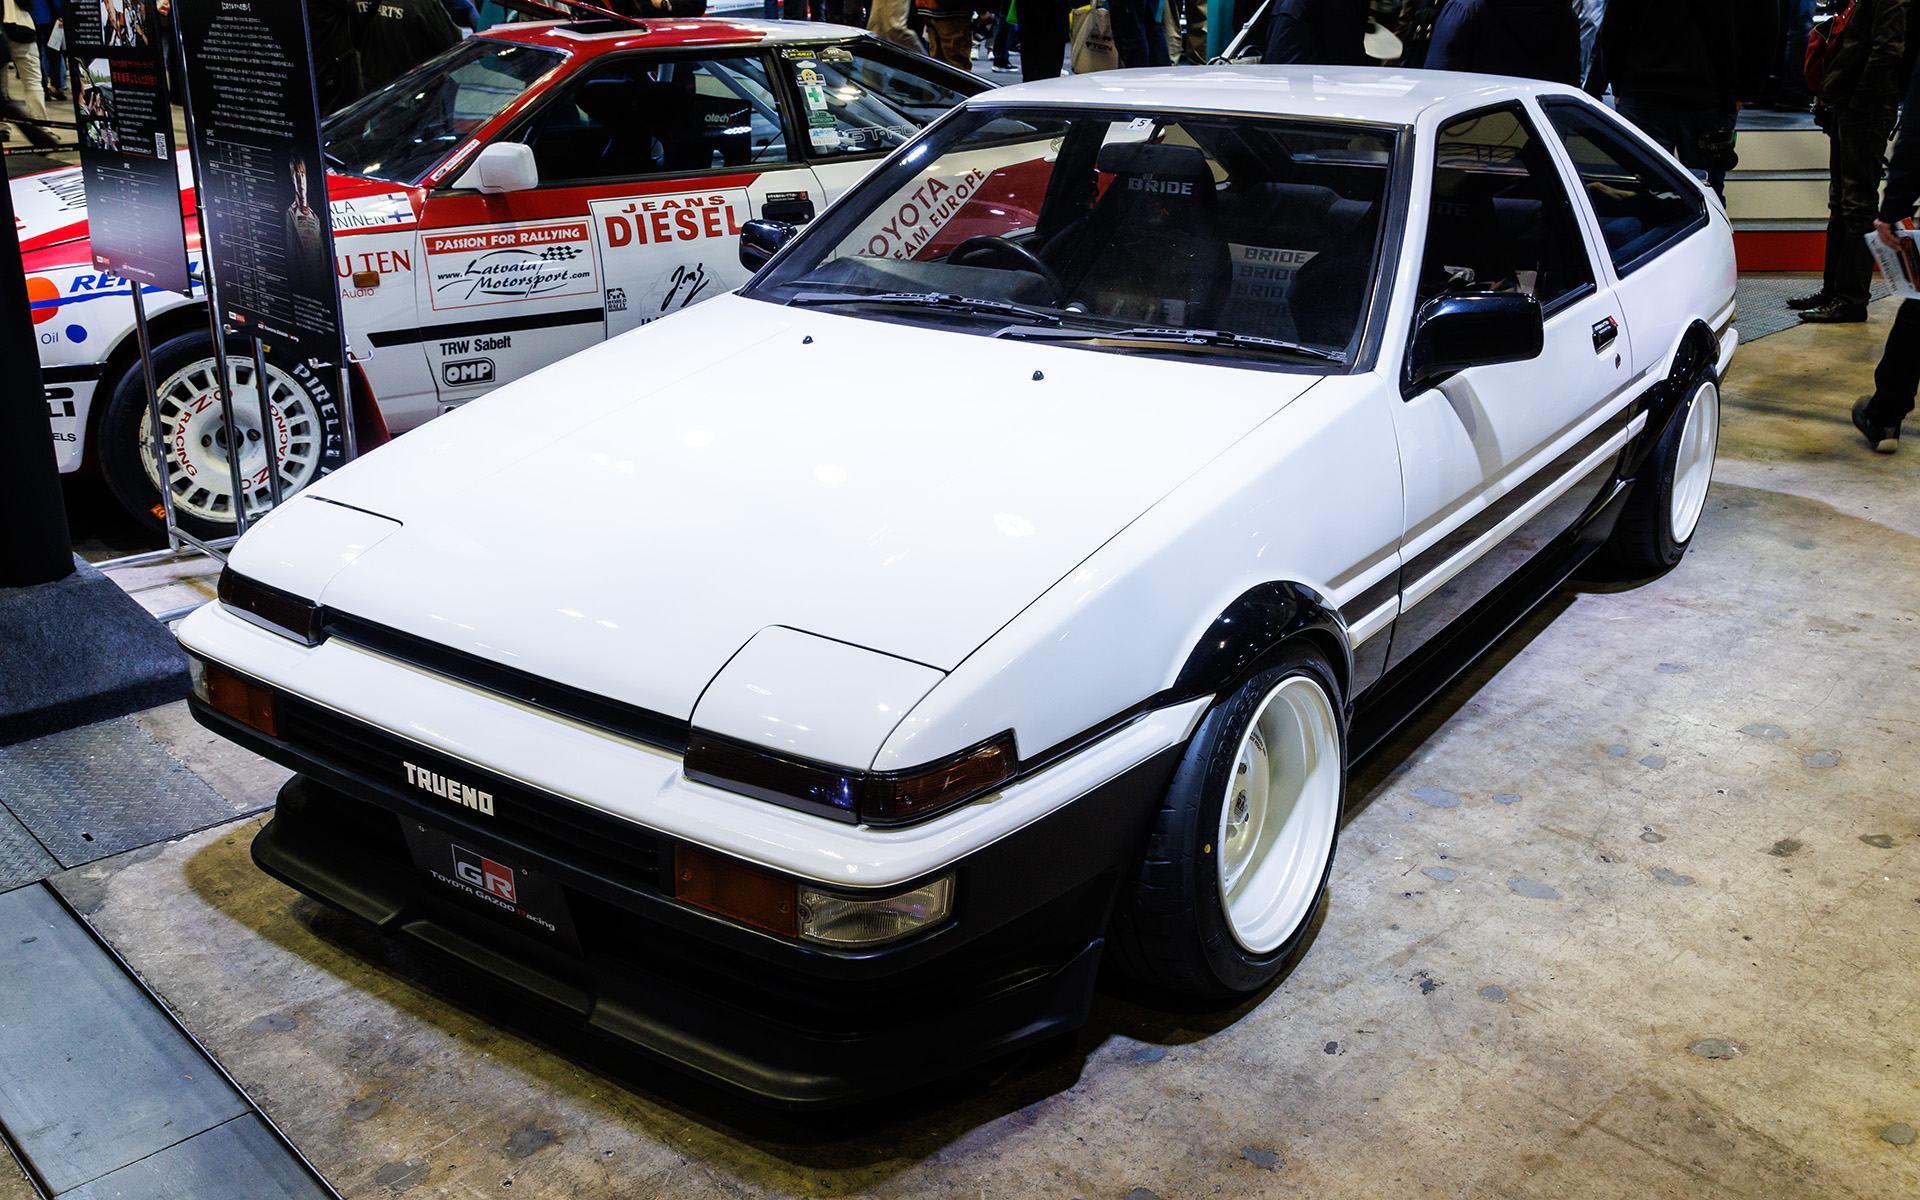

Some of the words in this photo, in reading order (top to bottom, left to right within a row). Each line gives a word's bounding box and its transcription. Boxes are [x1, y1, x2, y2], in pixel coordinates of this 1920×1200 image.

[1127, 177, 1194, 195] BRIDE
[622, 195, 726, 214] JEANS
[928, 168, 986, 229] EUROPE
[604, 205, 742, 248] DIESEL
[435, 236, 486, 251] PASSION
[491, 233, 516, 245] FOR
[520, 227, 581, 244] RALLYING
[358, 249, 412, 275] TEN
[1243, 247, 1307, 264] BRIDE
[341, 286, 375, 299] Audio
[41, 332, 59, 345] Oil
[440, 340, 470, 356] TRW
[474, 335, 512, 352] Sabelt
[444, 360, 492, 384] OMP
[175, 411, 199, 477] RACING
[403, 760, 495, 817] TRUENO
[456, 860, 514, 901] GR
[430, 869, 473, 894] TOYOTA
[475, 890, 515, 913] GAZOO
[517, 908, 556, 932] Racing
